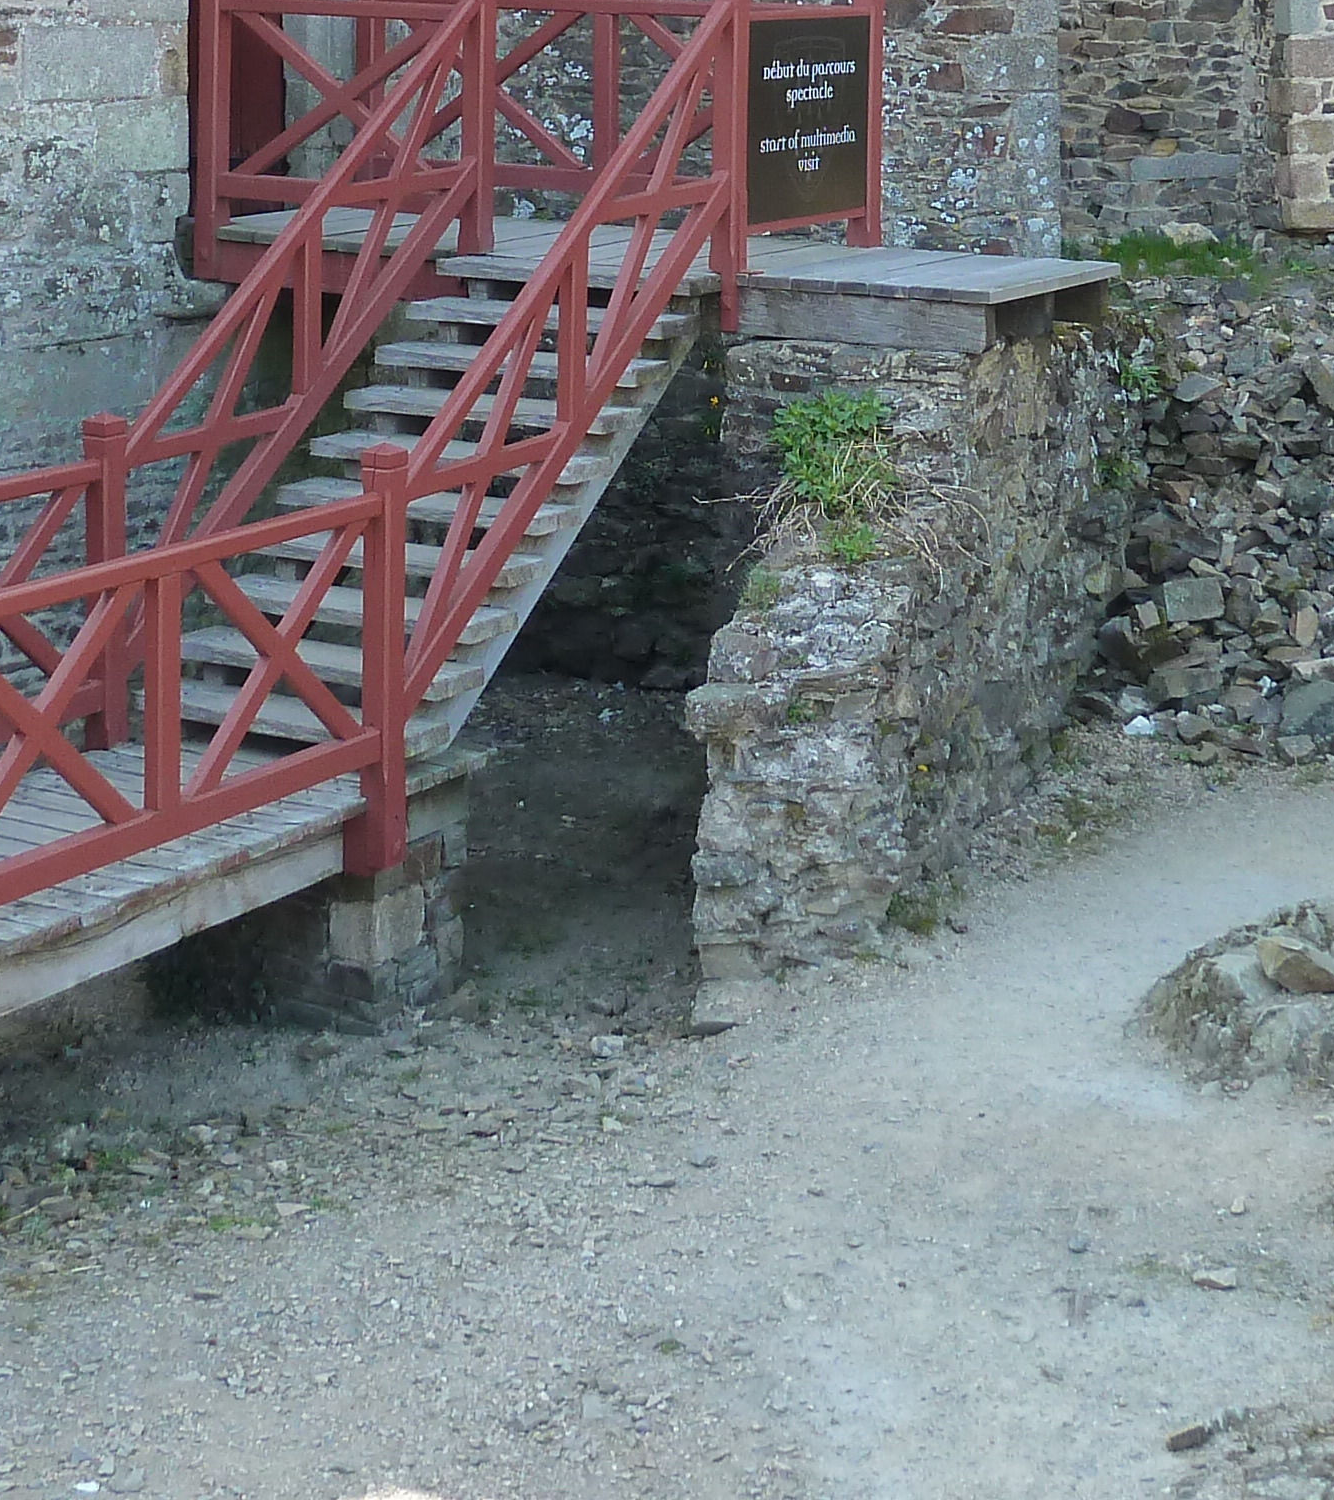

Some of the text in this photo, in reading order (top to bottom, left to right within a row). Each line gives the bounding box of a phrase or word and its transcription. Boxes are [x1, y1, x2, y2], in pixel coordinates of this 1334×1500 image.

[763, 58, 855, 82] Début du parcours
[786, 80, 833, 108] spectacle
[759, 124, 855, 153] start of multimedia
[798, 151, 820, 172] visit
